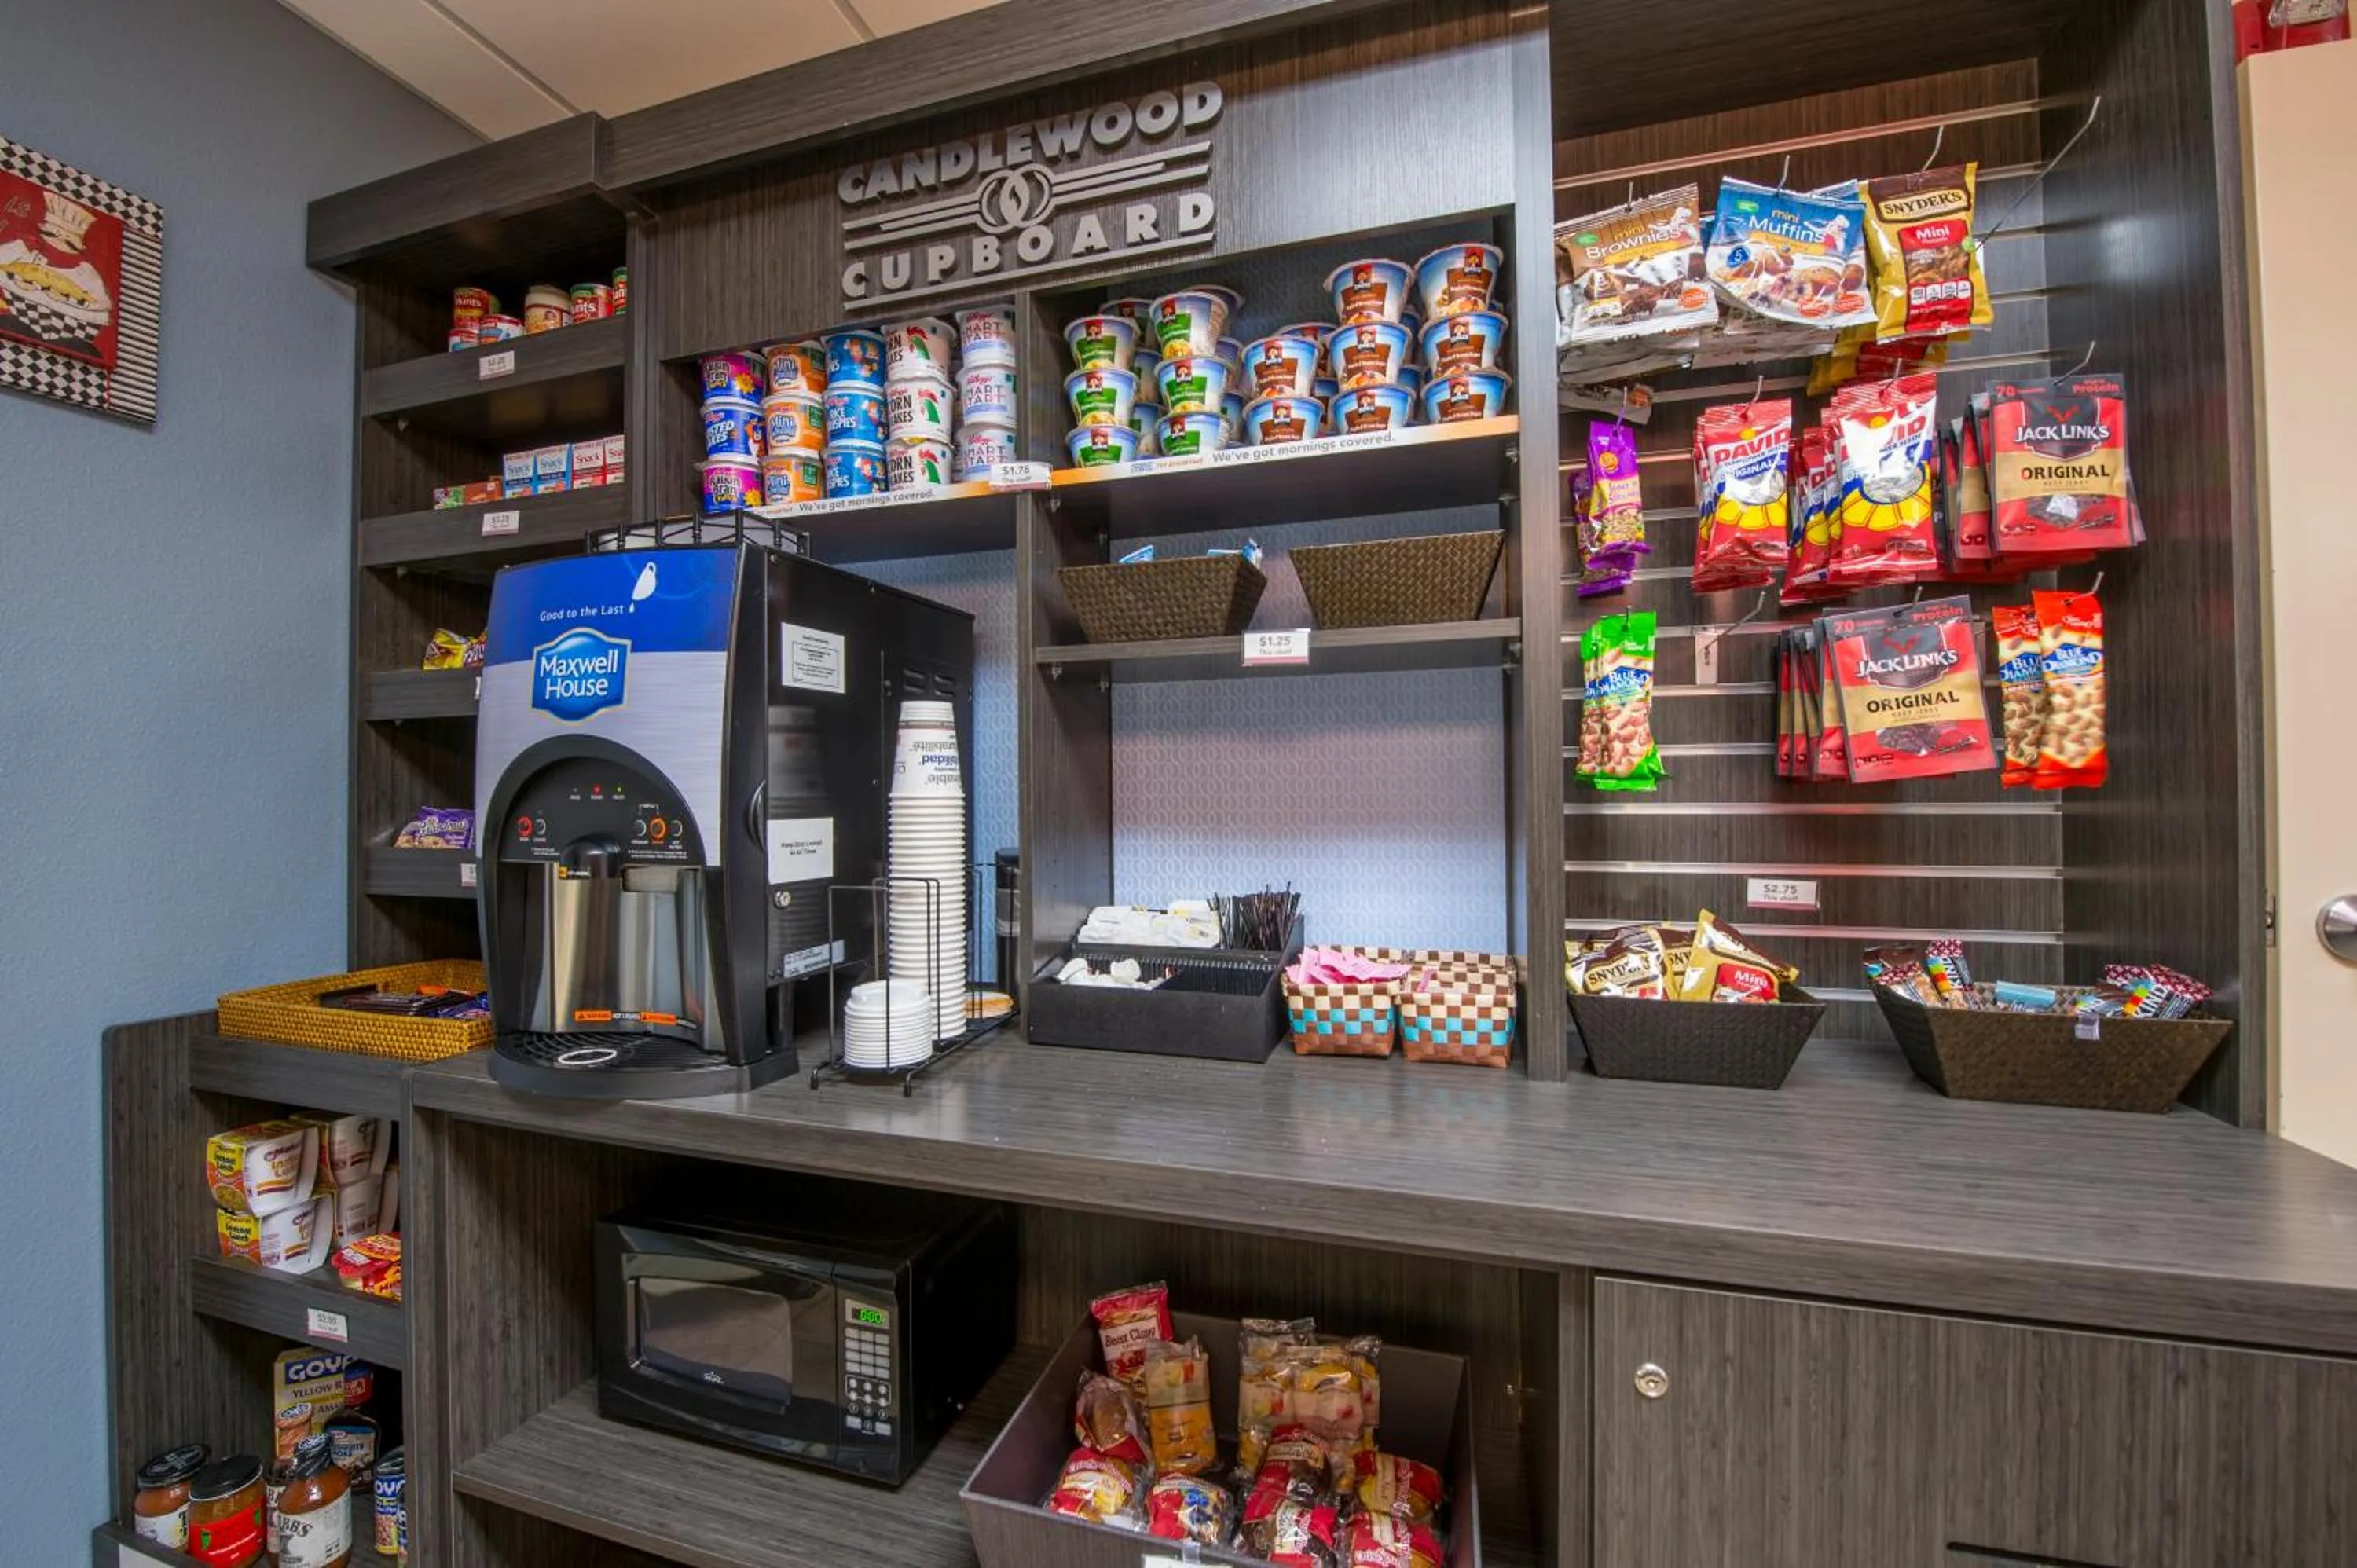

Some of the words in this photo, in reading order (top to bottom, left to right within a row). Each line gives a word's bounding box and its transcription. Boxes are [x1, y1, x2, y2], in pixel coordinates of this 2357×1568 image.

[837, 81, 1224, 204] CANDLEWOOD
[1883, 191, 1963, 214] SNYDER'S
[1772, 210, 1799, 223] mini
[1749, 215, 1826, 242] Muffins
[1915, 225, 1950, 240] Mini
[841, 192, 1215, 299] CUPBOARD
[1585, 229, 1681, 259] Brownies
[890, 394, 912, 412] ORN
[2015, 425, 2059, 442] JACK
[1211, 449, 1249, 463] We've
[1253, 447, 1275, 461] got
[1278, 440, 1336, 456] mornings
[1340, 432, 1395, 449] covered.
[1714, 427, 1791, 465] DAVID
[890, 456, 912, 471] ORN
[1002, 465, 1030, 476] $1.75
[2021, 465, 2110, 481] ORIGINAL
[829, 499, 845, 511] got
[848, 494, 890, 509] mornings
[540, 608, 564, 621] Good
[566, 609, 577, 618] to
[581, 606, 598, 617] the
[601, 604, 625, 615] Last
[1259, 636, 1292, 647] $1.25
[540, 649, 619, 678] Maxwell
[1857, 658, 1904, 678] JACK
[545, 678, 609, 700] House
[1866, 691, 1960, 713] ORIGINAL
[1764, 884, 1798, 895] $2.75
[2133, 984, 2168, 1019] KIND
[1105, 1333, 1128, 1347] Bear
[293, 1382, 332, 1399] YELLOW
